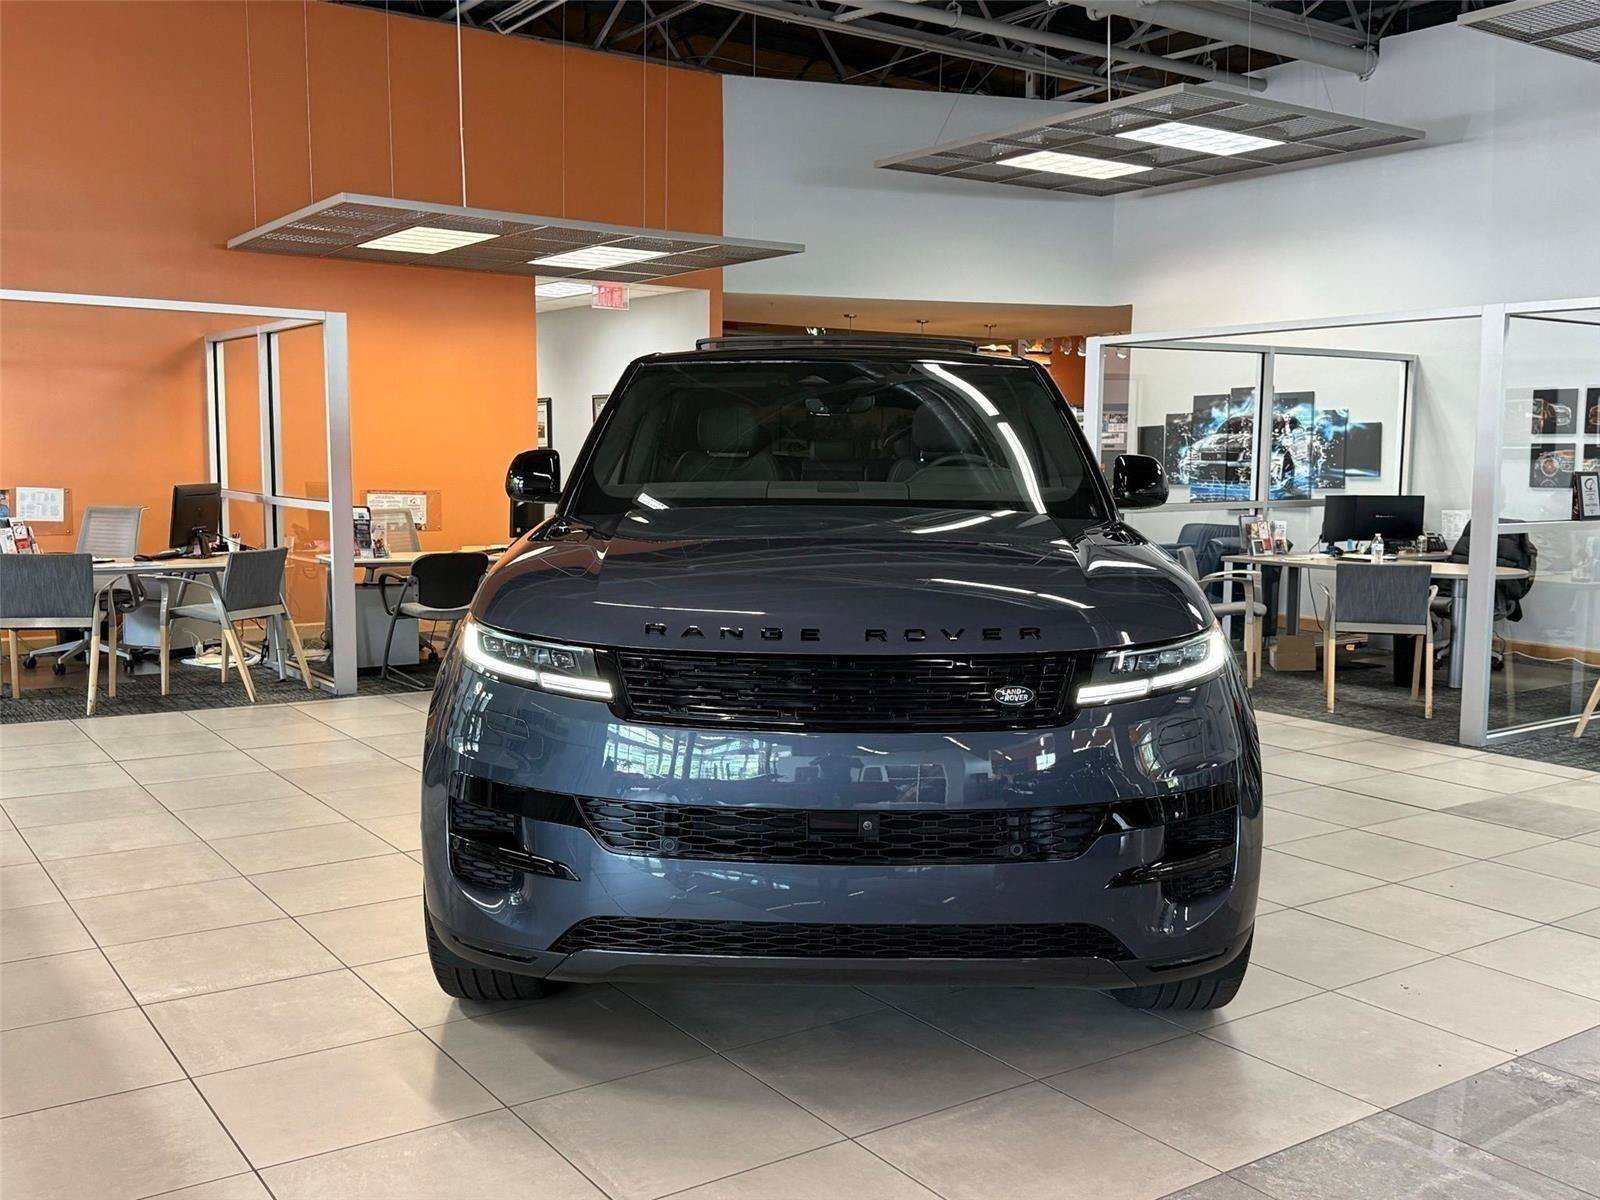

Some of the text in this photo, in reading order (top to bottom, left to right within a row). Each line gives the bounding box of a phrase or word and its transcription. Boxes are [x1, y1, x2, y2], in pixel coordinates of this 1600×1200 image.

[644, 622, 1042, 643] RANGE ROVER
[1001, 688, 1021, 696] LAND
[1004, 693, 1029, 701] ROVER
